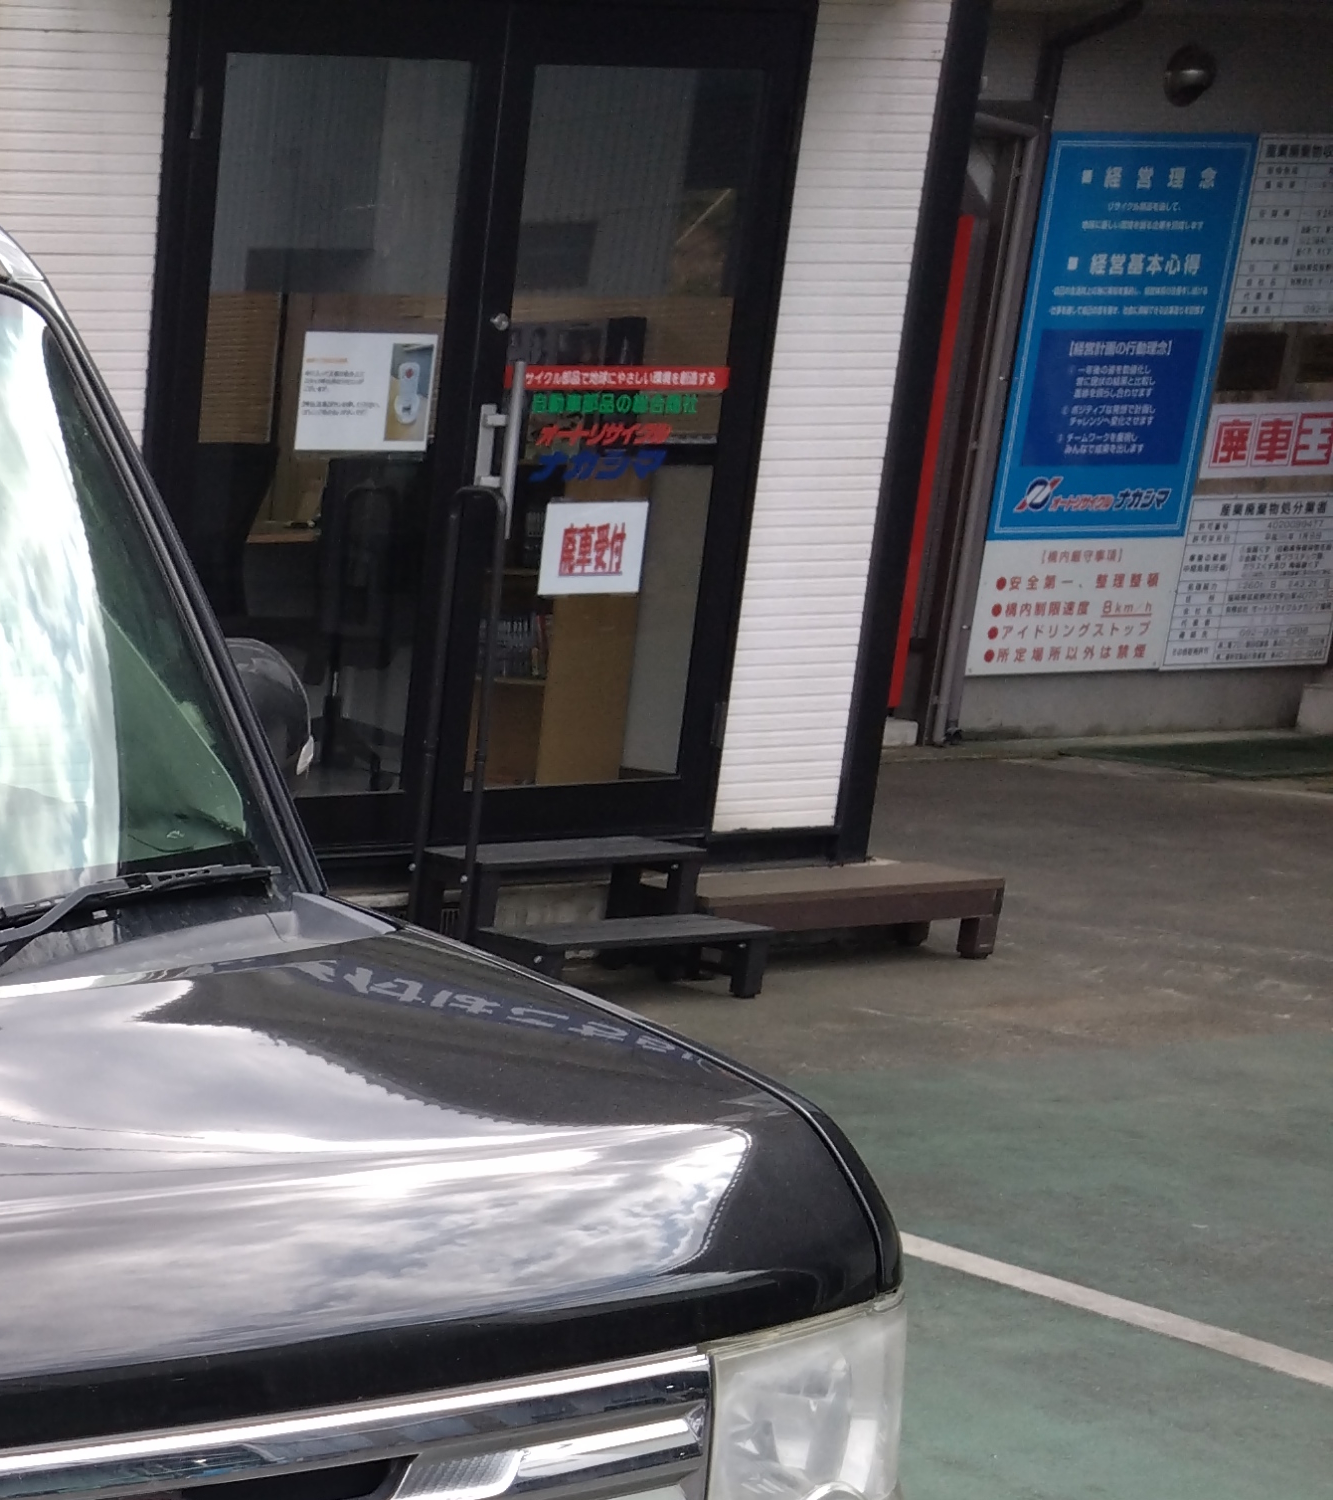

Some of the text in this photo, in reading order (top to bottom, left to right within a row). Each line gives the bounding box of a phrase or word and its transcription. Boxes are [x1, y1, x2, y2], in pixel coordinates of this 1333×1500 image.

[1089, 253, 1202, 276] 経営基本心得
[529, 449, 667, 482] ナカシマ
[1113, 488, 1171, 510] ナカシマ
[1002, 622, 1151, 640] アイドリングストップ
[996, 644, 1147, 663] 所定場所以外は禁煙
